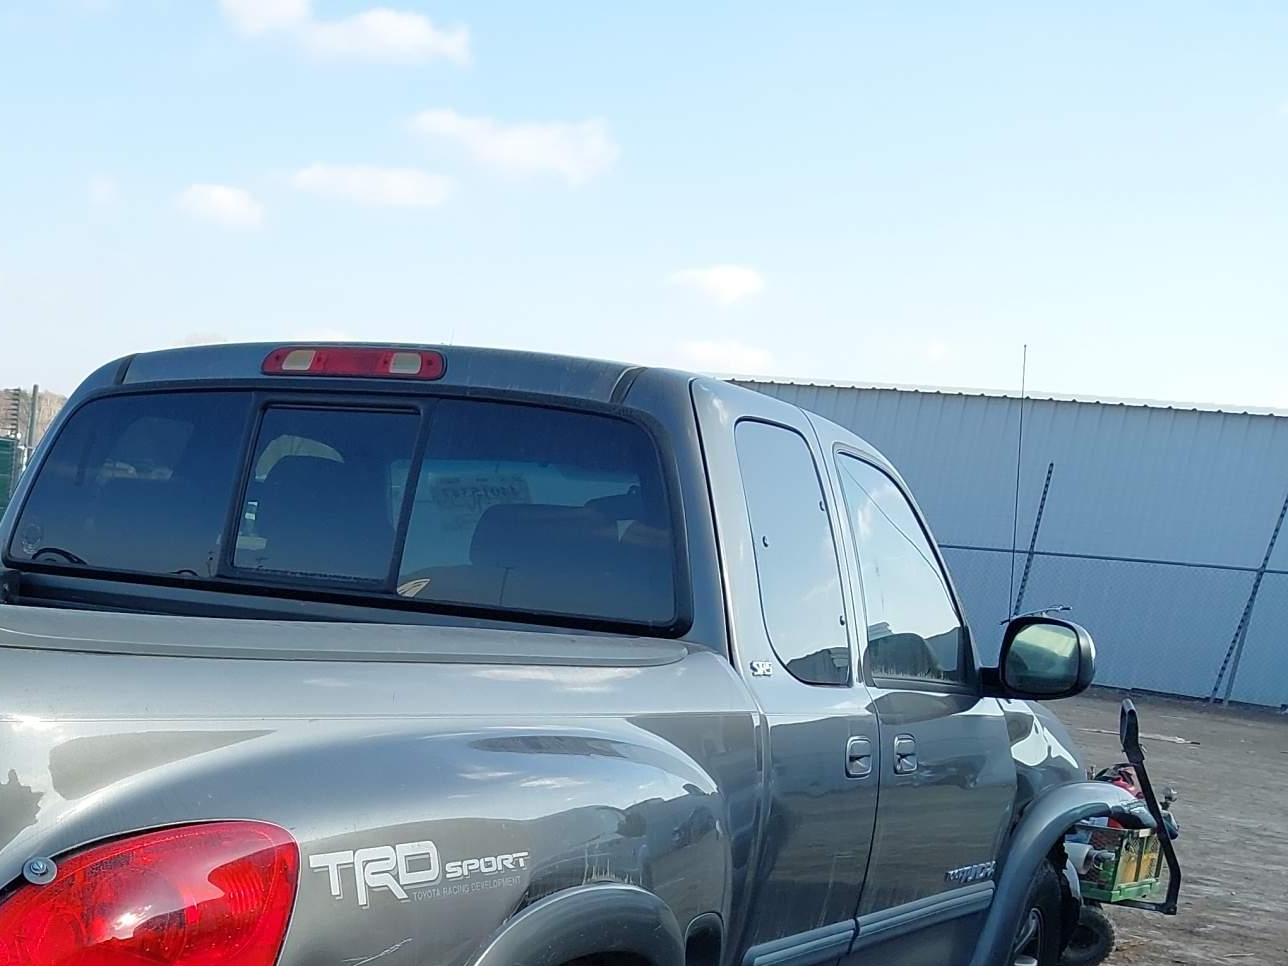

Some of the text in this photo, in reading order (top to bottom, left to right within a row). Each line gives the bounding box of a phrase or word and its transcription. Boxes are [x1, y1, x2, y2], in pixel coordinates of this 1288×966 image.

[750, 661, 773, 677] SR5
[309, 841, 529, 907] TRD SPORT
[413, 875, 521, 902] TOYOTA RACING DEVELOPMENT
